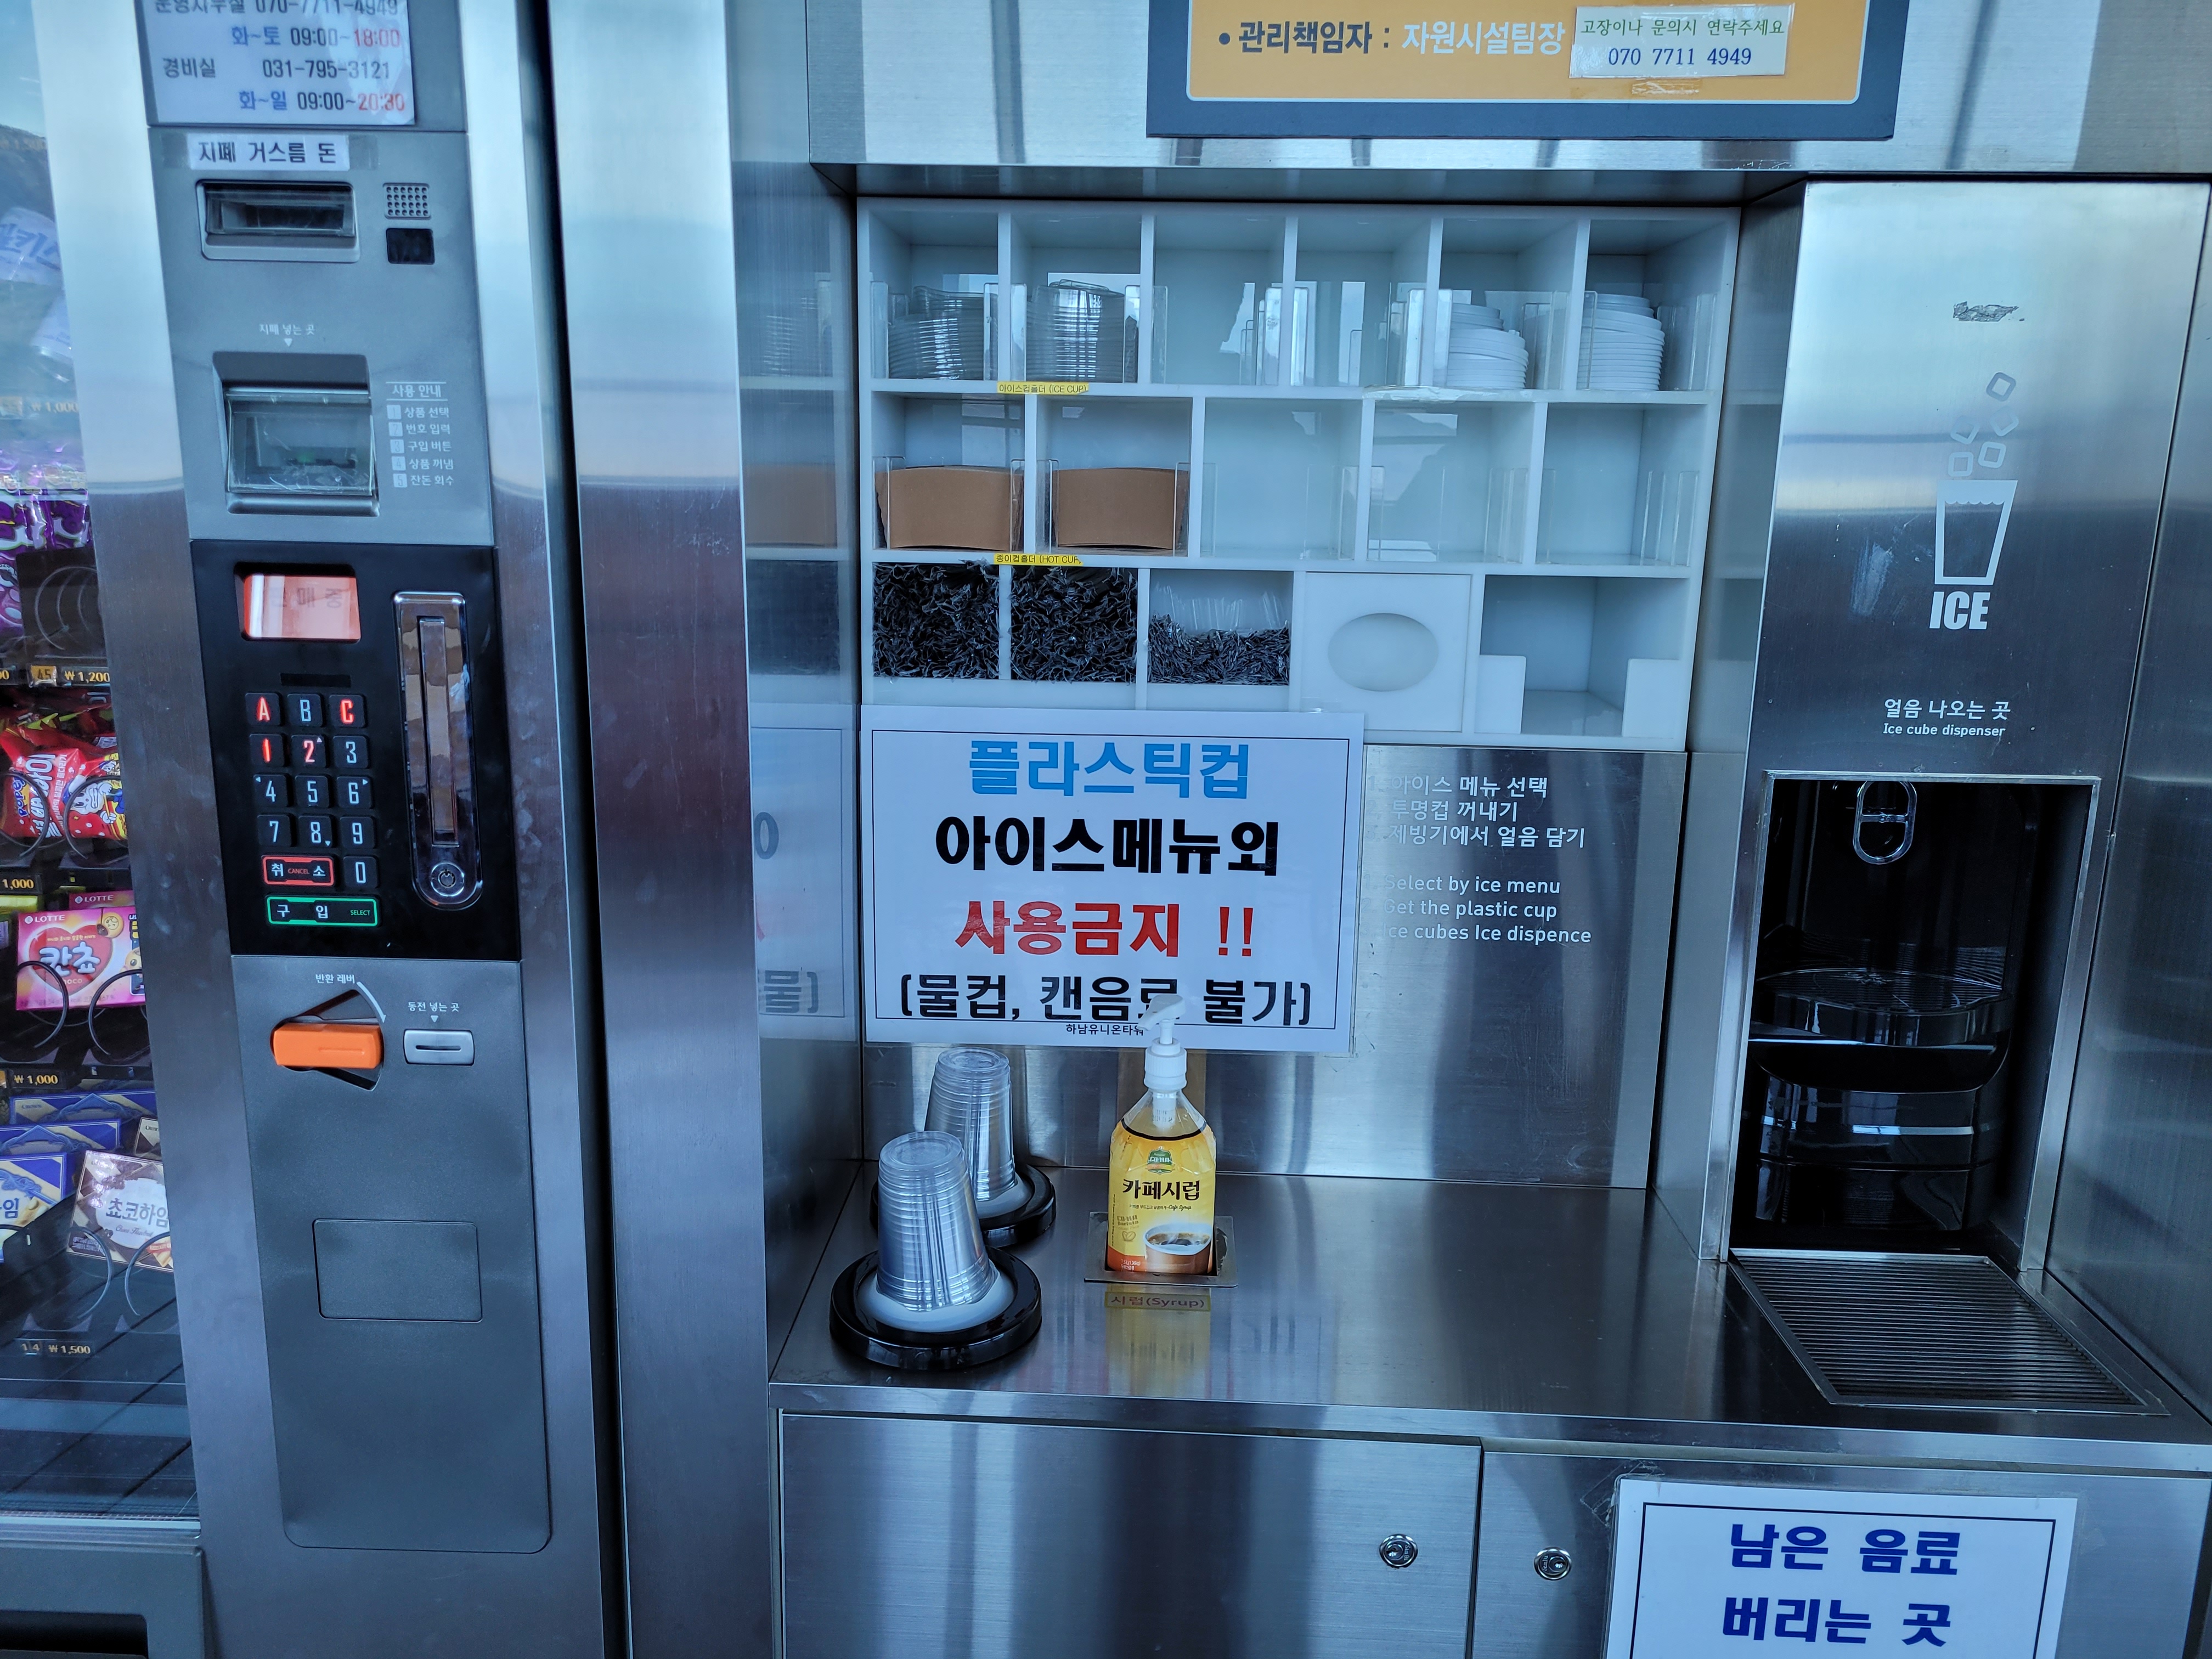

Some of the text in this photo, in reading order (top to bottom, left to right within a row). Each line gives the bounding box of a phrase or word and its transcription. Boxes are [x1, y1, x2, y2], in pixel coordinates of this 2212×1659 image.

[1238, 20, 1373, 55] 관리책임자
[1401, 21, 1565, 57] 자원시설팀장
[1580, 19, 1785, 37] 고장이나 문의시 연락주세요
[1607, 47, 1752, 66] 070 7711 4949
[162, 58, 390, 80] 경비실 031-795-3121
[199, 141, 337, 164] 지폐 거스름 돈
[282, 324, 302, 336] 넣는
[305, 324, 316, 335] 곳
[392, 385, 442, 398] 사용 안내
[998, 384, 1087, 394] 아이스컵홀더 (ICE CUP)
[404, 407, 426, 419] 상품
[429, 407, 450, 419] 선택
[406, 423, 426, 436] 번호
[430, 423, 451, 436] 입력
[407, 441, 428, 453] 구입
[431, 440, 453, 453] 버튼
[409, 458, 430, 470] 상품
[433, 458, 454, 470] 꺼냄
[410, 474, 432, 487] 잔돈
[436, 474, 455, 487] 회수
[996, 554, 1036, 563] 종이컵홀더
[1039, 555, 1059, 563] (HOT
[1928, 590, 1991, 630] ICE
[258, 697, 270, 722] A
[300, 699, 312, 722] B
[340, 698, 354, 724] C
[1884, 698, 2011, 720] 얼음 나오는 곳
[1883, 723, 2006, 738] Ice cube dispenser
[263, 738, 270, 764] 1
[303, 740, 315, 763] 2
[346, 741, 357, 764] 3
[968, 740, 1250, 800] 플라스틱컵
[266, 780, 275, 802] 4
[307, 781, 318, 803] 5
[348, 782, 359, 804] 6
[1391, 775, 1452, 795] 아이스
[1459, 776, 1501, 797] 메뉴
[1506, 777, 1548, 798] 선택
[1390, 800, 1449, 821] 투명컵
[1457, 801, 1518, 822] 꺼내기
[269, 821, 279, 843] 7
[311, 821, 321, 844] 8
[352, 822, 363, 845] 9
[1388, 825, 1489, 847] 제빙기에서
[1497, 826, 1539, 848] 얼음
[1545, 827, 1585, 849] 담기
[935, 815, 1280, 876] 아이스메뉴외
[271, 863, 326, 877] 취 소
[355, 861, 366, 884] 0
[1384, 874, 1443, 891] Select
[1449, 876, 1470, 895] by
[1475, 876, 1502, 893] ice
[1507, 879, 1561, 894] menu
[276, 904, 329, 920] 구 입
[349, 909, 371, 917] SELECT
[1384, 899, 1415, 915] Get
[1420, 900, 1451, 916] the
[1455, 900, 1518, 919] plastic
[1523, 904, 1558, 922] cup
[955, 900, 1254, 957] 사용금지 !!
[1383, 922, 1408, 939] Ice
[1414, 923, 1469, 940] cubes
[1475, 924, 1502, 941] Ice
[1507, 925, 1592, 945] dispence
[39, 941, 101, 978] 칸쵸
[315, 974, 356, 985] 반환 레버
[408, 1001, 460, 1013] 동전 넣는 곳
[1203, 977, 1312, 1026] 불가)
[1122, 1179, 1200, 1201] 카페시럽
[0, 1198, 20, 1219] 임
[106, 1198, 168, 1229] 초코하임
[1730, 1522, 1961, 1576] 남은 음료
[1722, 1596, 1951, 1647] 버리는 곳
